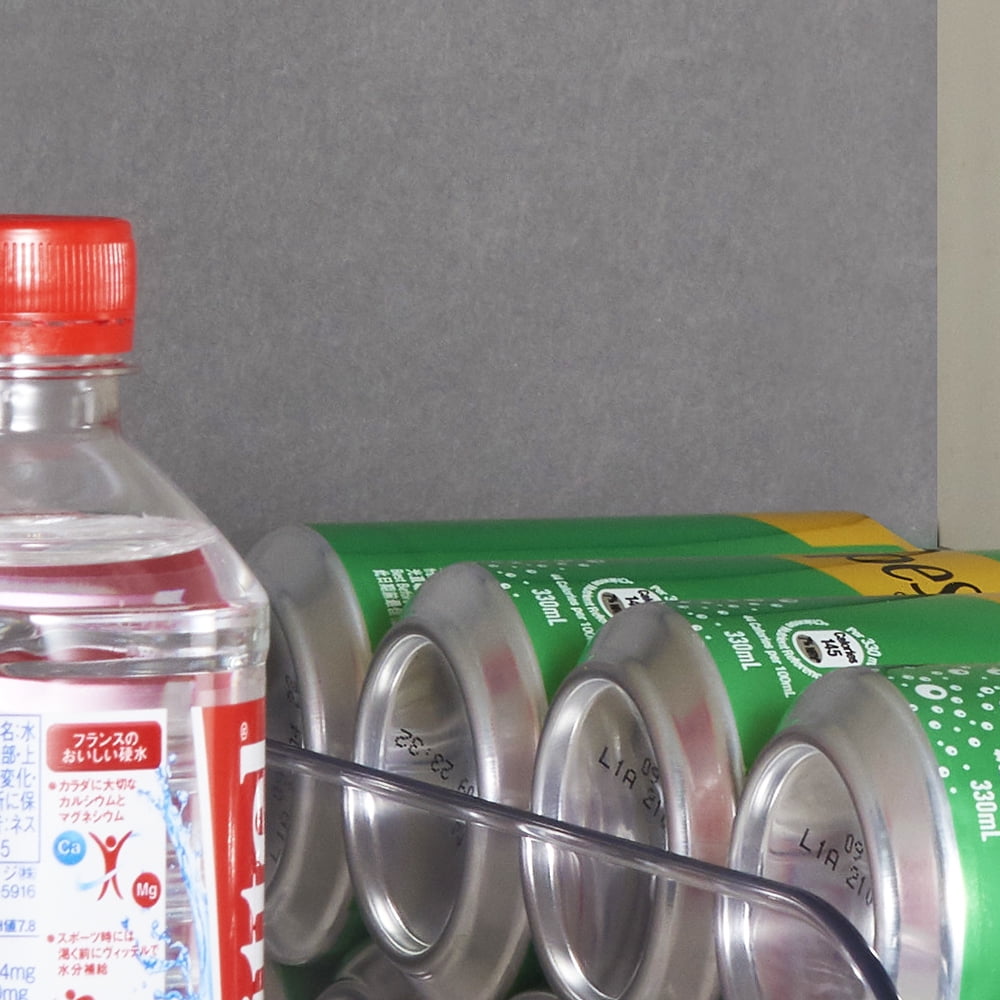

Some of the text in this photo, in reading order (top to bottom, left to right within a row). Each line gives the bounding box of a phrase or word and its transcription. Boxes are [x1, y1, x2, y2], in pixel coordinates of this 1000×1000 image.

[724, 630, 763, 671] 330mL
[821, 639, 843, 657] 145
[72, 731, 140, 749] フランスの
[62, 746, 148, 764] おいしい硬水
[58, 809, 125, 824] マグネシウム
[57, 838, 82, 856] Ca
[798, 827, 840, 872] L1A
[135, 881, 158, 900] Mg
